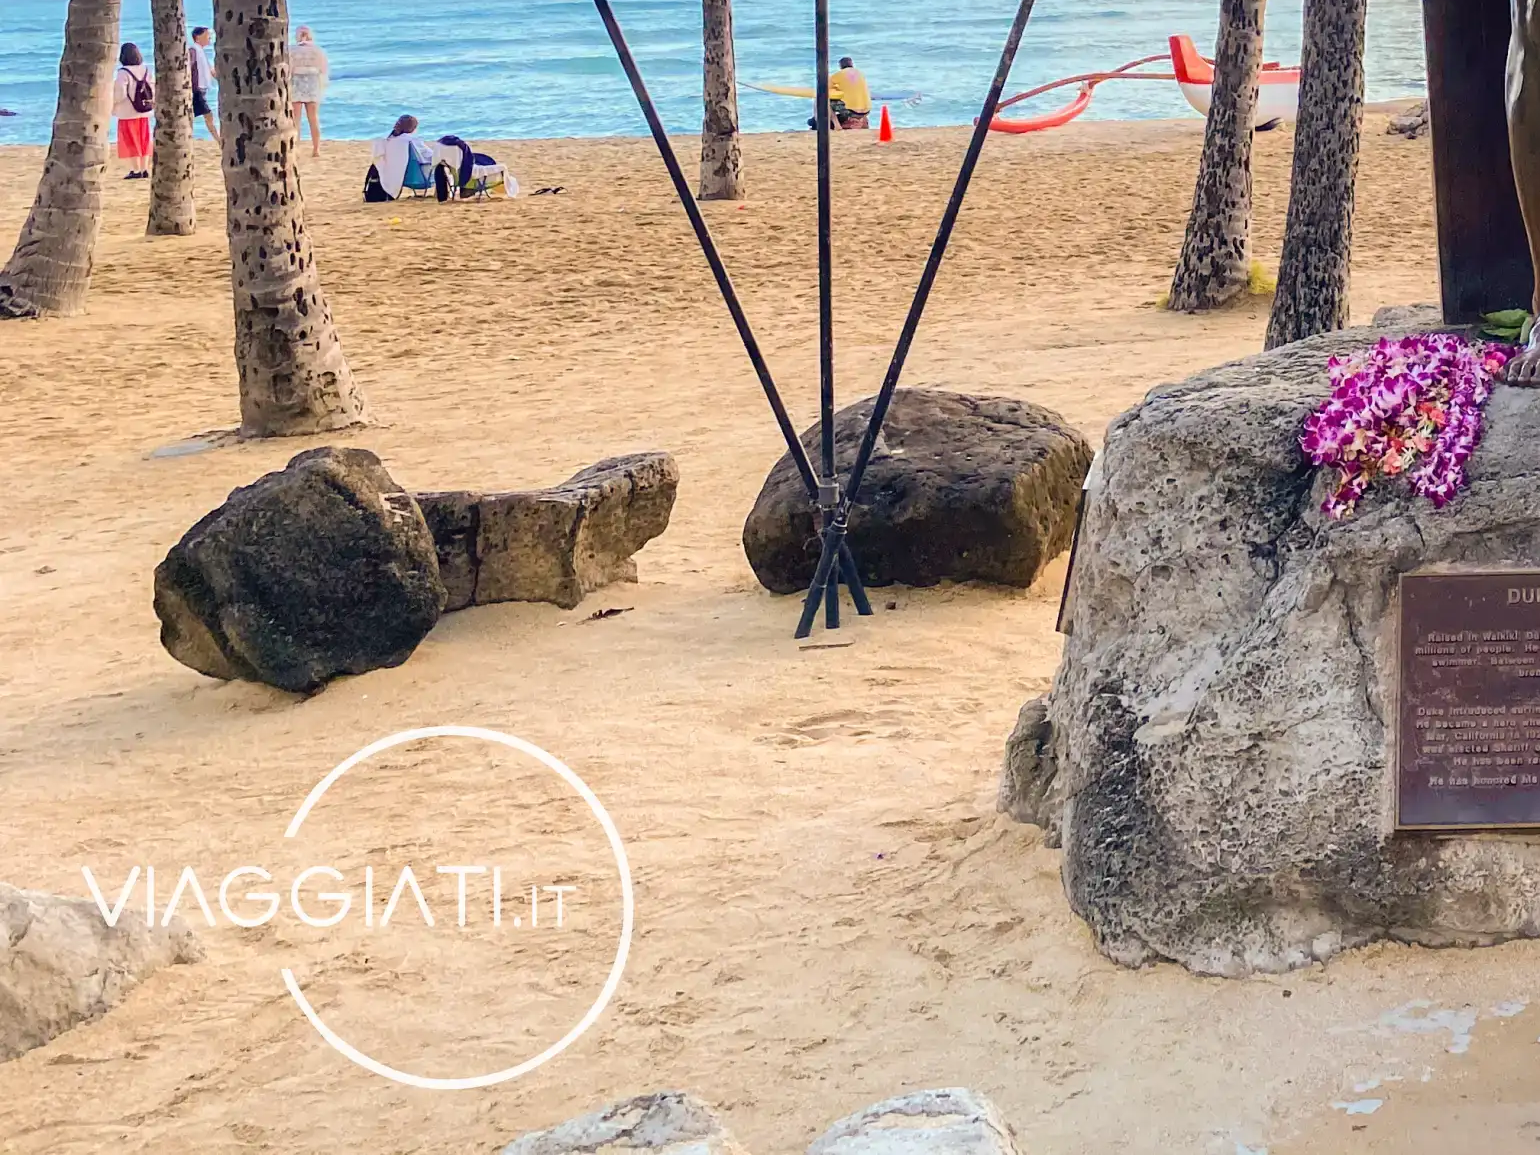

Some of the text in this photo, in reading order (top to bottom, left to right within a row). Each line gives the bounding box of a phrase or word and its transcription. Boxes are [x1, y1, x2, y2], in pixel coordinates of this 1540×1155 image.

[1428, 632, 1463, 642] Raised
[1415, 645, 1455, 655] millions
[1460, 645, 1472, 654] of
[1524, 643, 1540, 653] He
[1490, 655, 1535, 665] Between
[1417, 707, 1444, 717] Duke
[1450, 706, 1506, 716] introduced
[1416, 719, 1431, 729] He
[1435, 718, 1476, 728] became
[1481, 720, 1488, 728] a
[1493, 718, 1516, 727] hero
[1454, 730, 1505, 740] California
[1422, 746, 1445, 754] was
[1449, 743, 1489, 753] elected
[1493, 742, 1529, 752] Sheriff
[1453, 756, 1468, 766] He
[1472, 756, 1492, 765] has
[1496, 755, 1524, 765] been
[1429, 777, 1444, 786] He
[1449, 776, 1468, 786] has
[1472, 776, 1517, 785] honored
[1521, 775, 1538, 785] his
